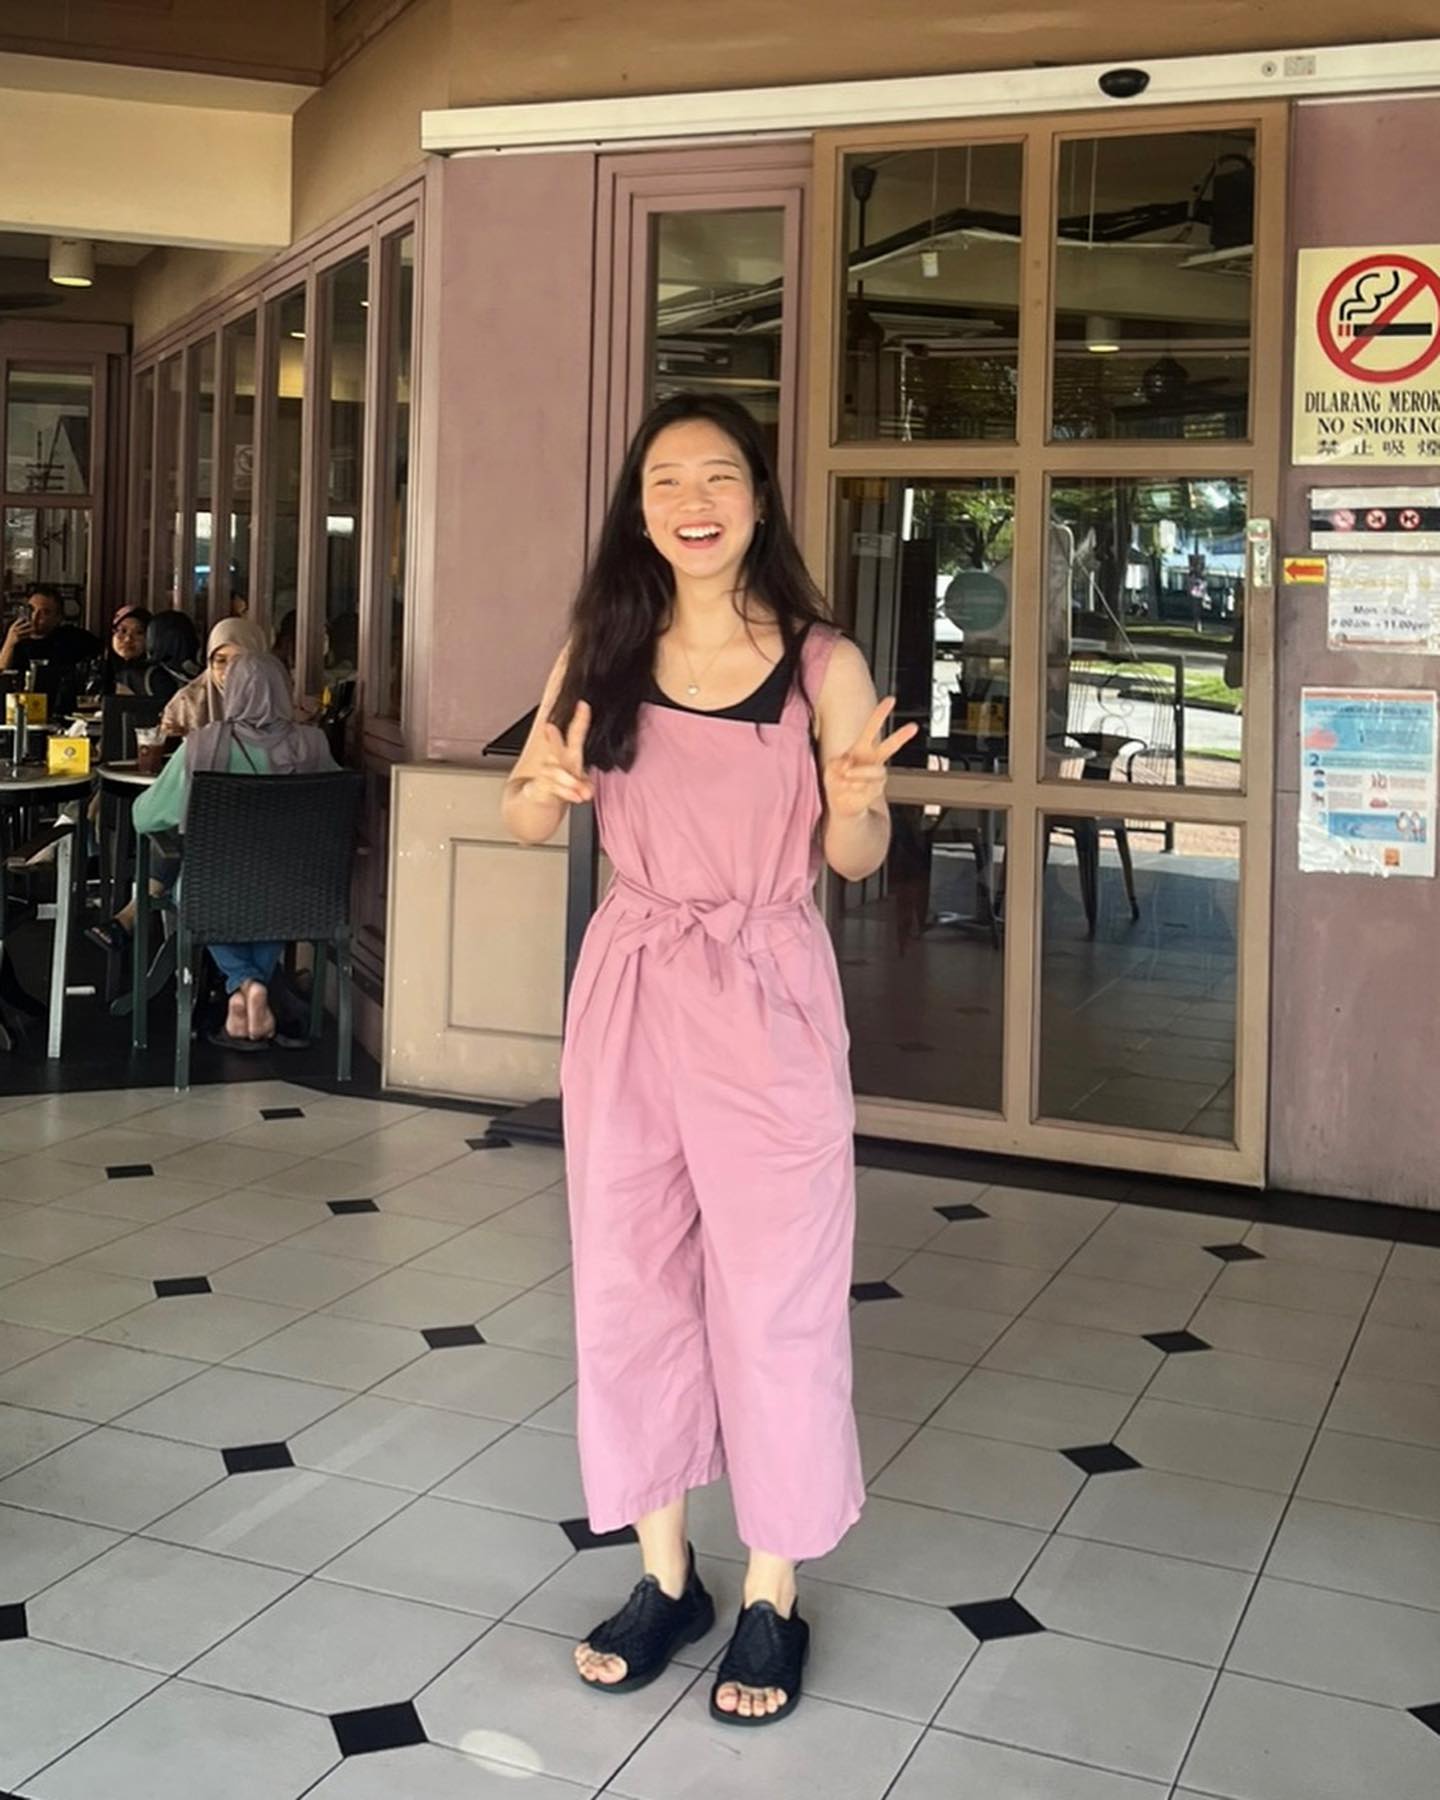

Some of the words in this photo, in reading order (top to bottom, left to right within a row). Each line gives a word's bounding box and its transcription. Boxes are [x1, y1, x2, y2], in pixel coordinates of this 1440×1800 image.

[1305, 391, 1381, 413] DILARANG
[1318, 417, 1345, 434] NO
[1309, 754, 1320, 767] 2
